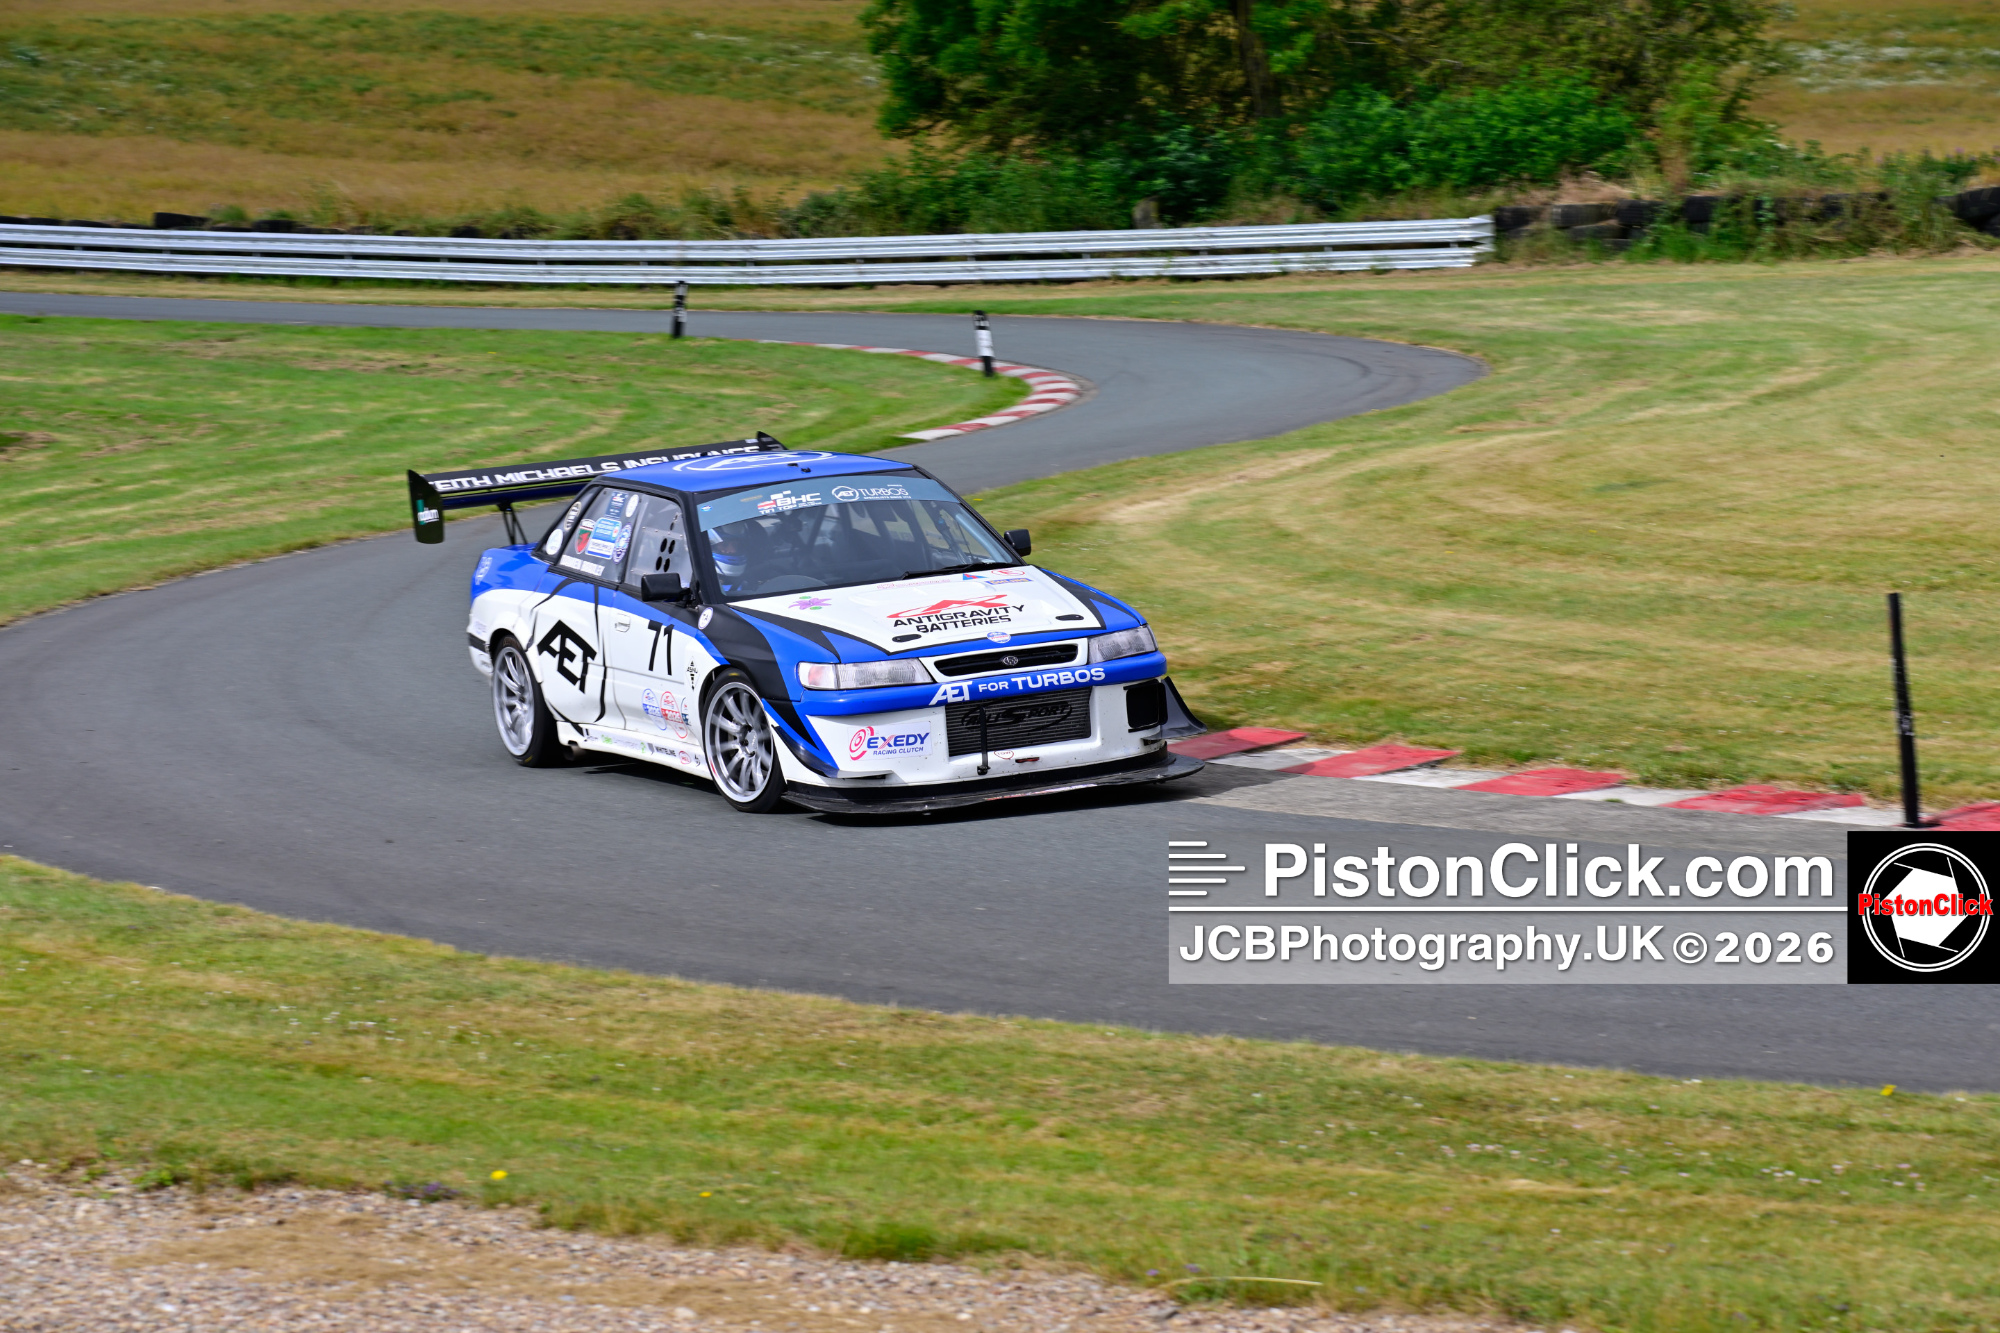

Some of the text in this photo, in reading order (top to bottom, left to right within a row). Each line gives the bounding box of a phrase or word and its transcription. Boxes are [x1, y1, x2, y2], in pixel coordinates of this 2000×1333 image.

[428, 475, 493, 491] EITH
[494, 461, 622, 484] MICHAELS
[776, 492, 822, 507] BHC
[858, 487, 909, 497] TURBOS
[893, 604, 1025, 627] ANTIGRAVITY
[915, 614, 1012, 634] BATTERIES
[647, 619, 675, 676] 71
[978, 681, 1009, 693] FOR
[1011, 667, 1106, 690] TURBOS
[866, 731, 930, 749] EXEDY
[872, 746, 924, 756] RACING CLUTCH
